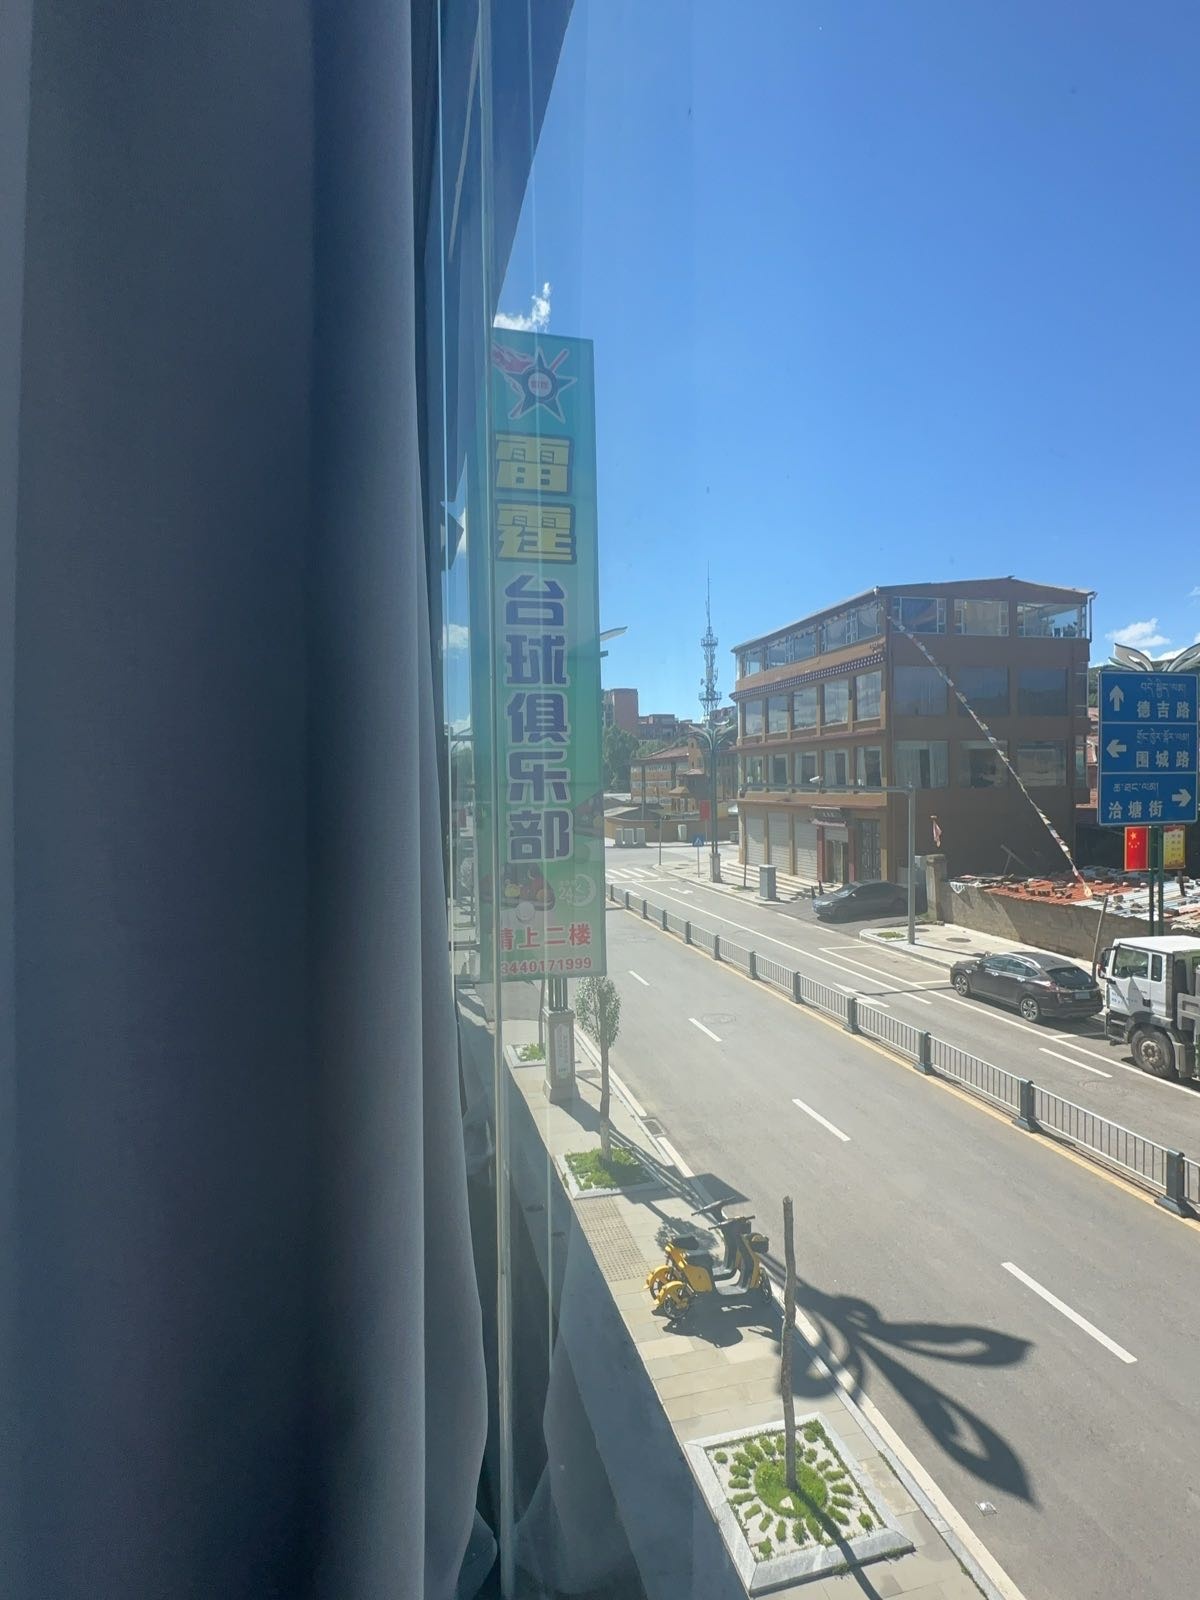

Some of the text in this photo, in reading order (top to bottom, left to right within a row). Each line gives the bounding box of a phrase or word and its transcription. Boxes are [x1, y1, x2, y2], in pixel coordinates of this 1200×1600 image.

[1136, 700, 1190, 719] 德吉路
[1135, 750, 1190, 769] 围城路
[1108, 800, 1163, 819] 洽塘街
